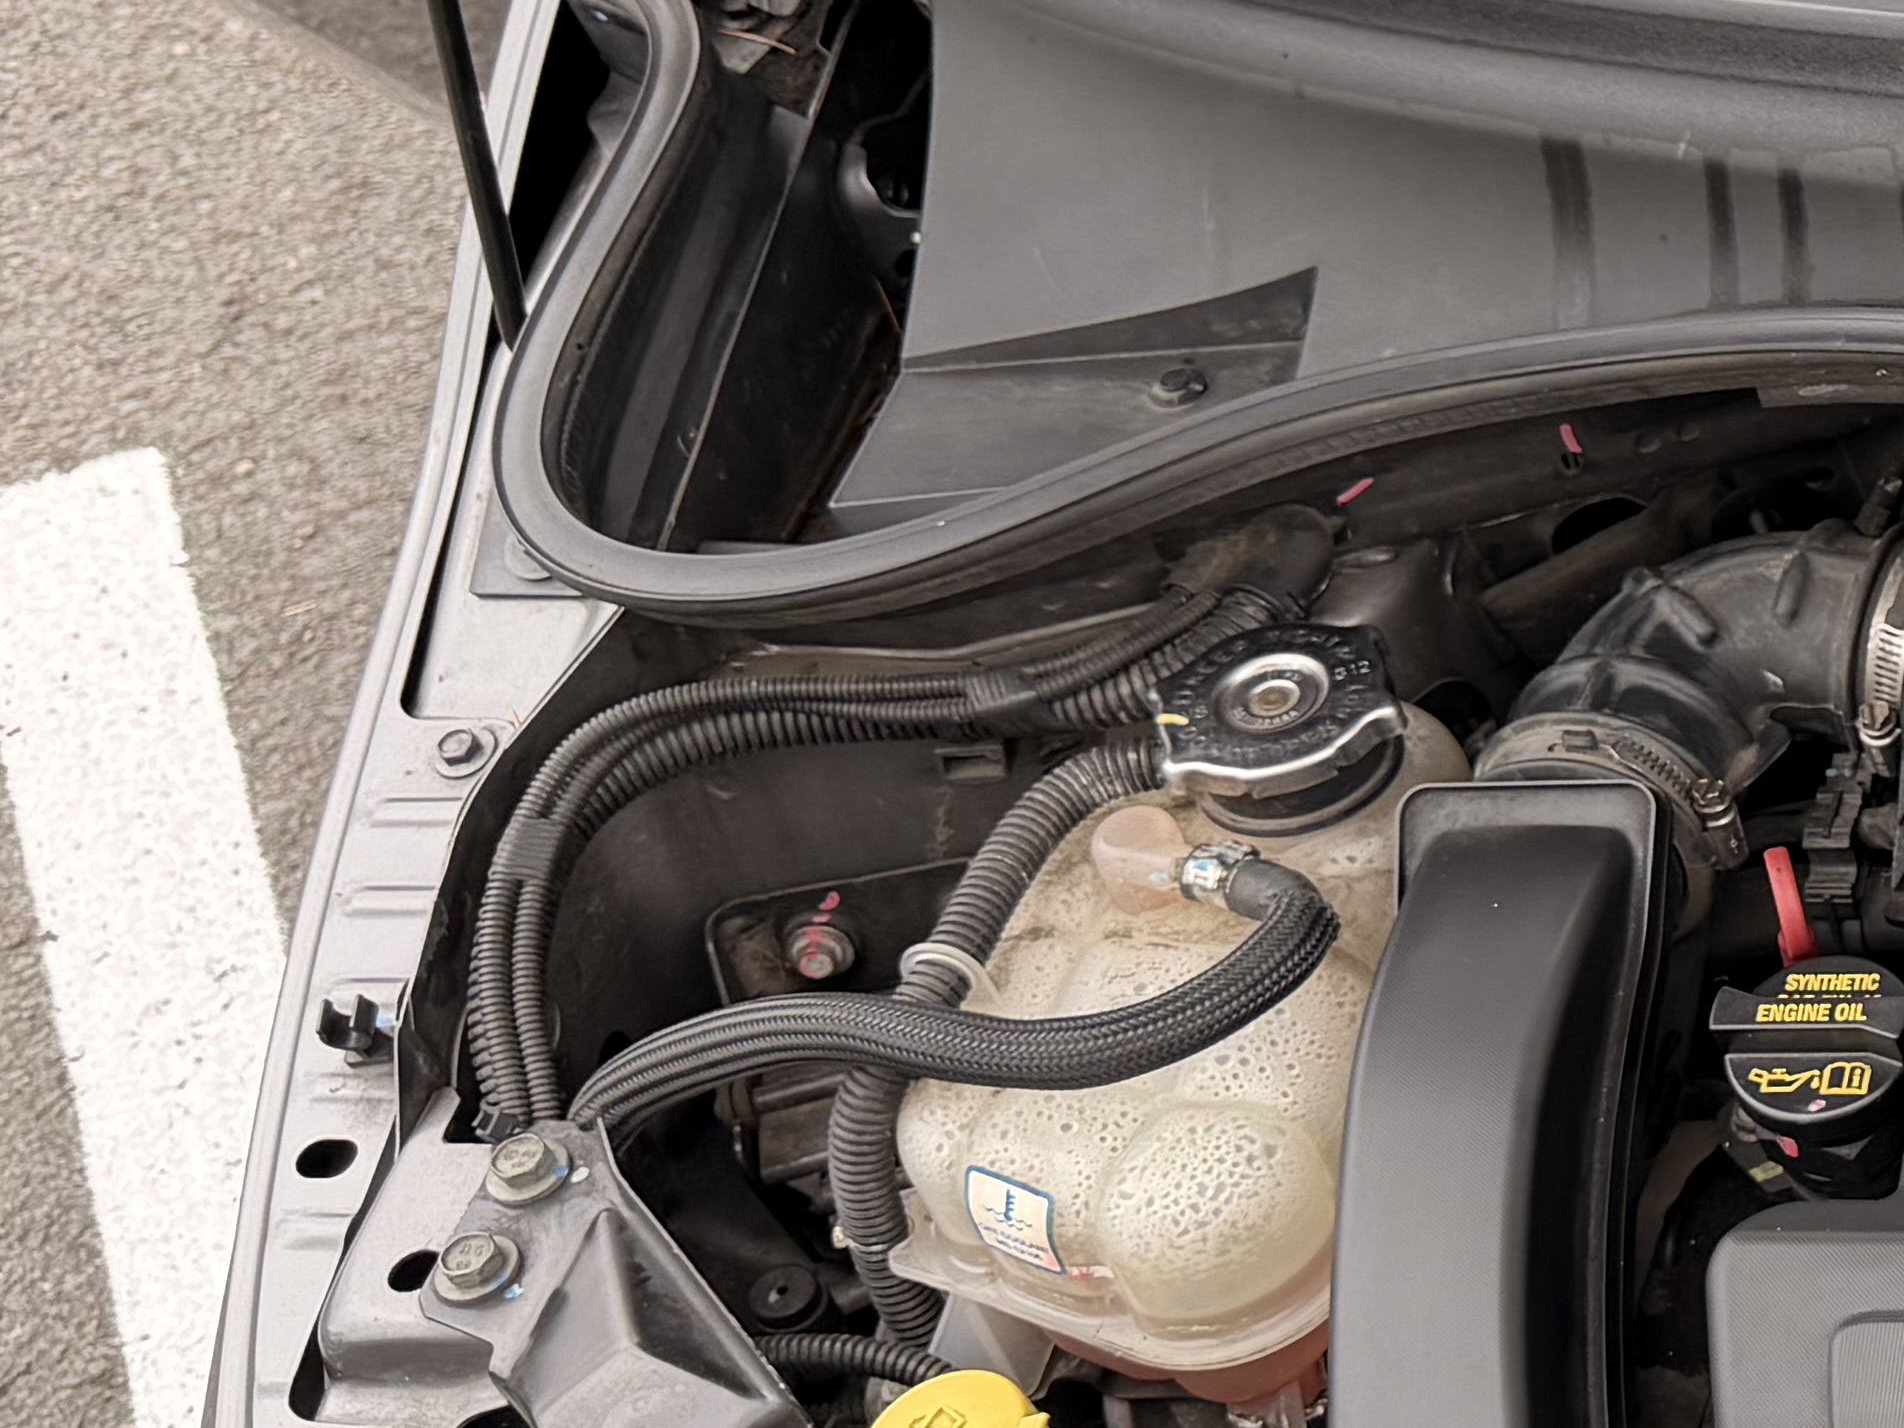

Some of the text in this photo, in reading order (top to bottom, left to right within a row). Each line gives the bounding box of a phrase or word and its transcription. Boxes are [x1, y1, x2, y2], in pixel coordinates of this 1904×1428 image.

[1784, 973, 1881, 991] SYNTHETIC
[1755, 1003, 1867, 1022] ENGINE OIL
